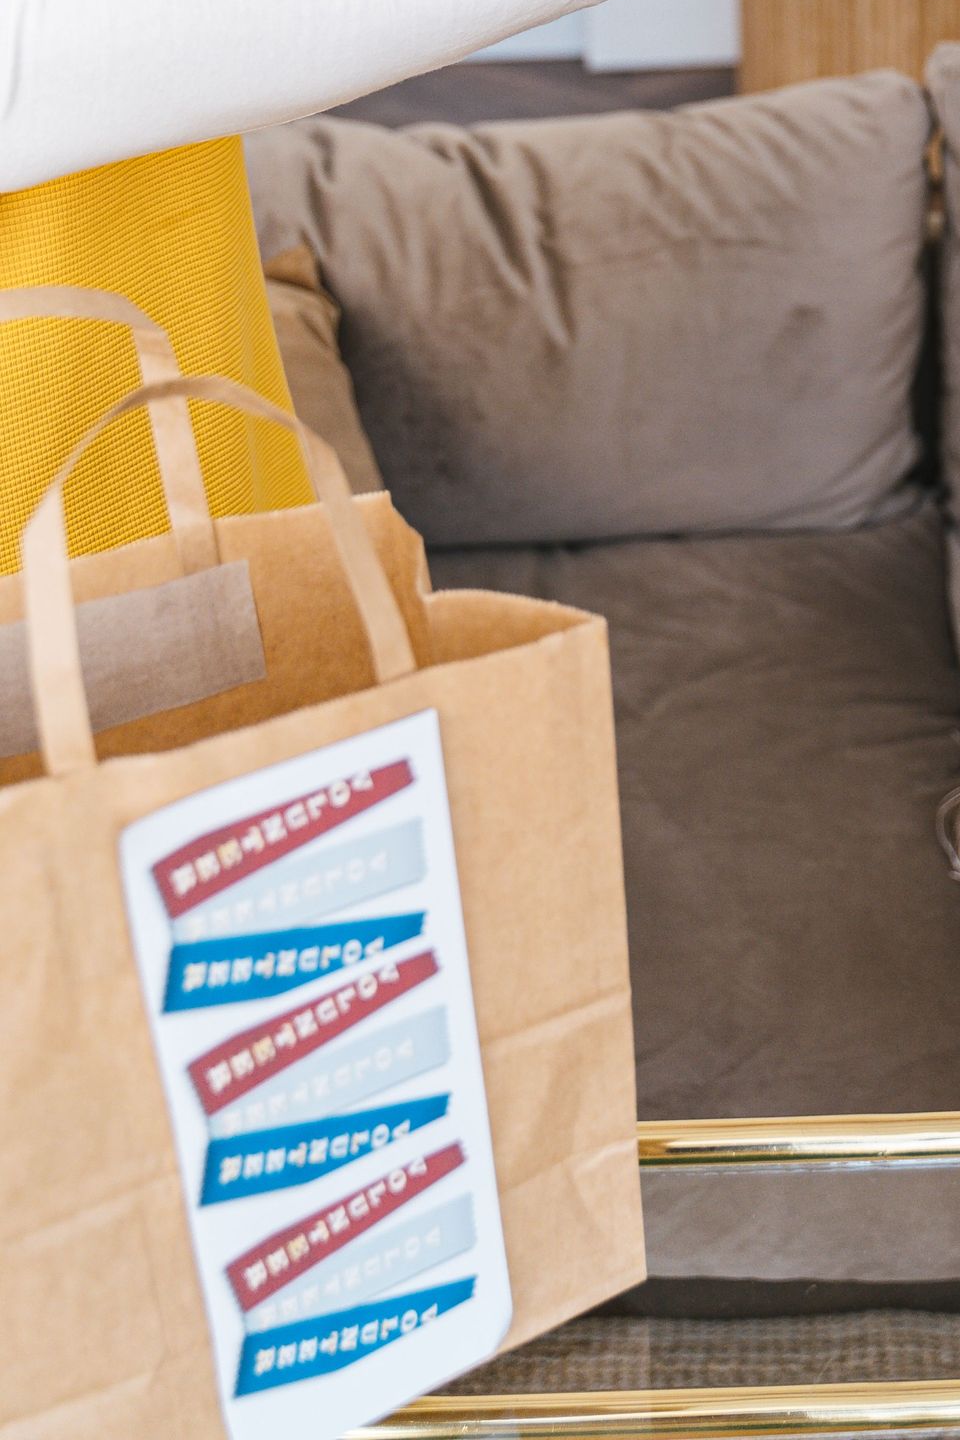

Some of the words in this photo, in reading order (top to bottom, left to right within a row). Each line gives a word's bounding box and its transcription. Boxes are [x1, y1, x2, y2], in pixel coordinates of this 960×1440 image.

[182, 937, 385, 992] VOLUNTEER
[205, 963, 401, 1094] VOLUNTEER
[219, 1119, 412, 1184] VOLUNTEER
[243, 1158, 428, 1291] VOLUNTEER
[255, 1303, 440, 1377] VOLUNTEER
